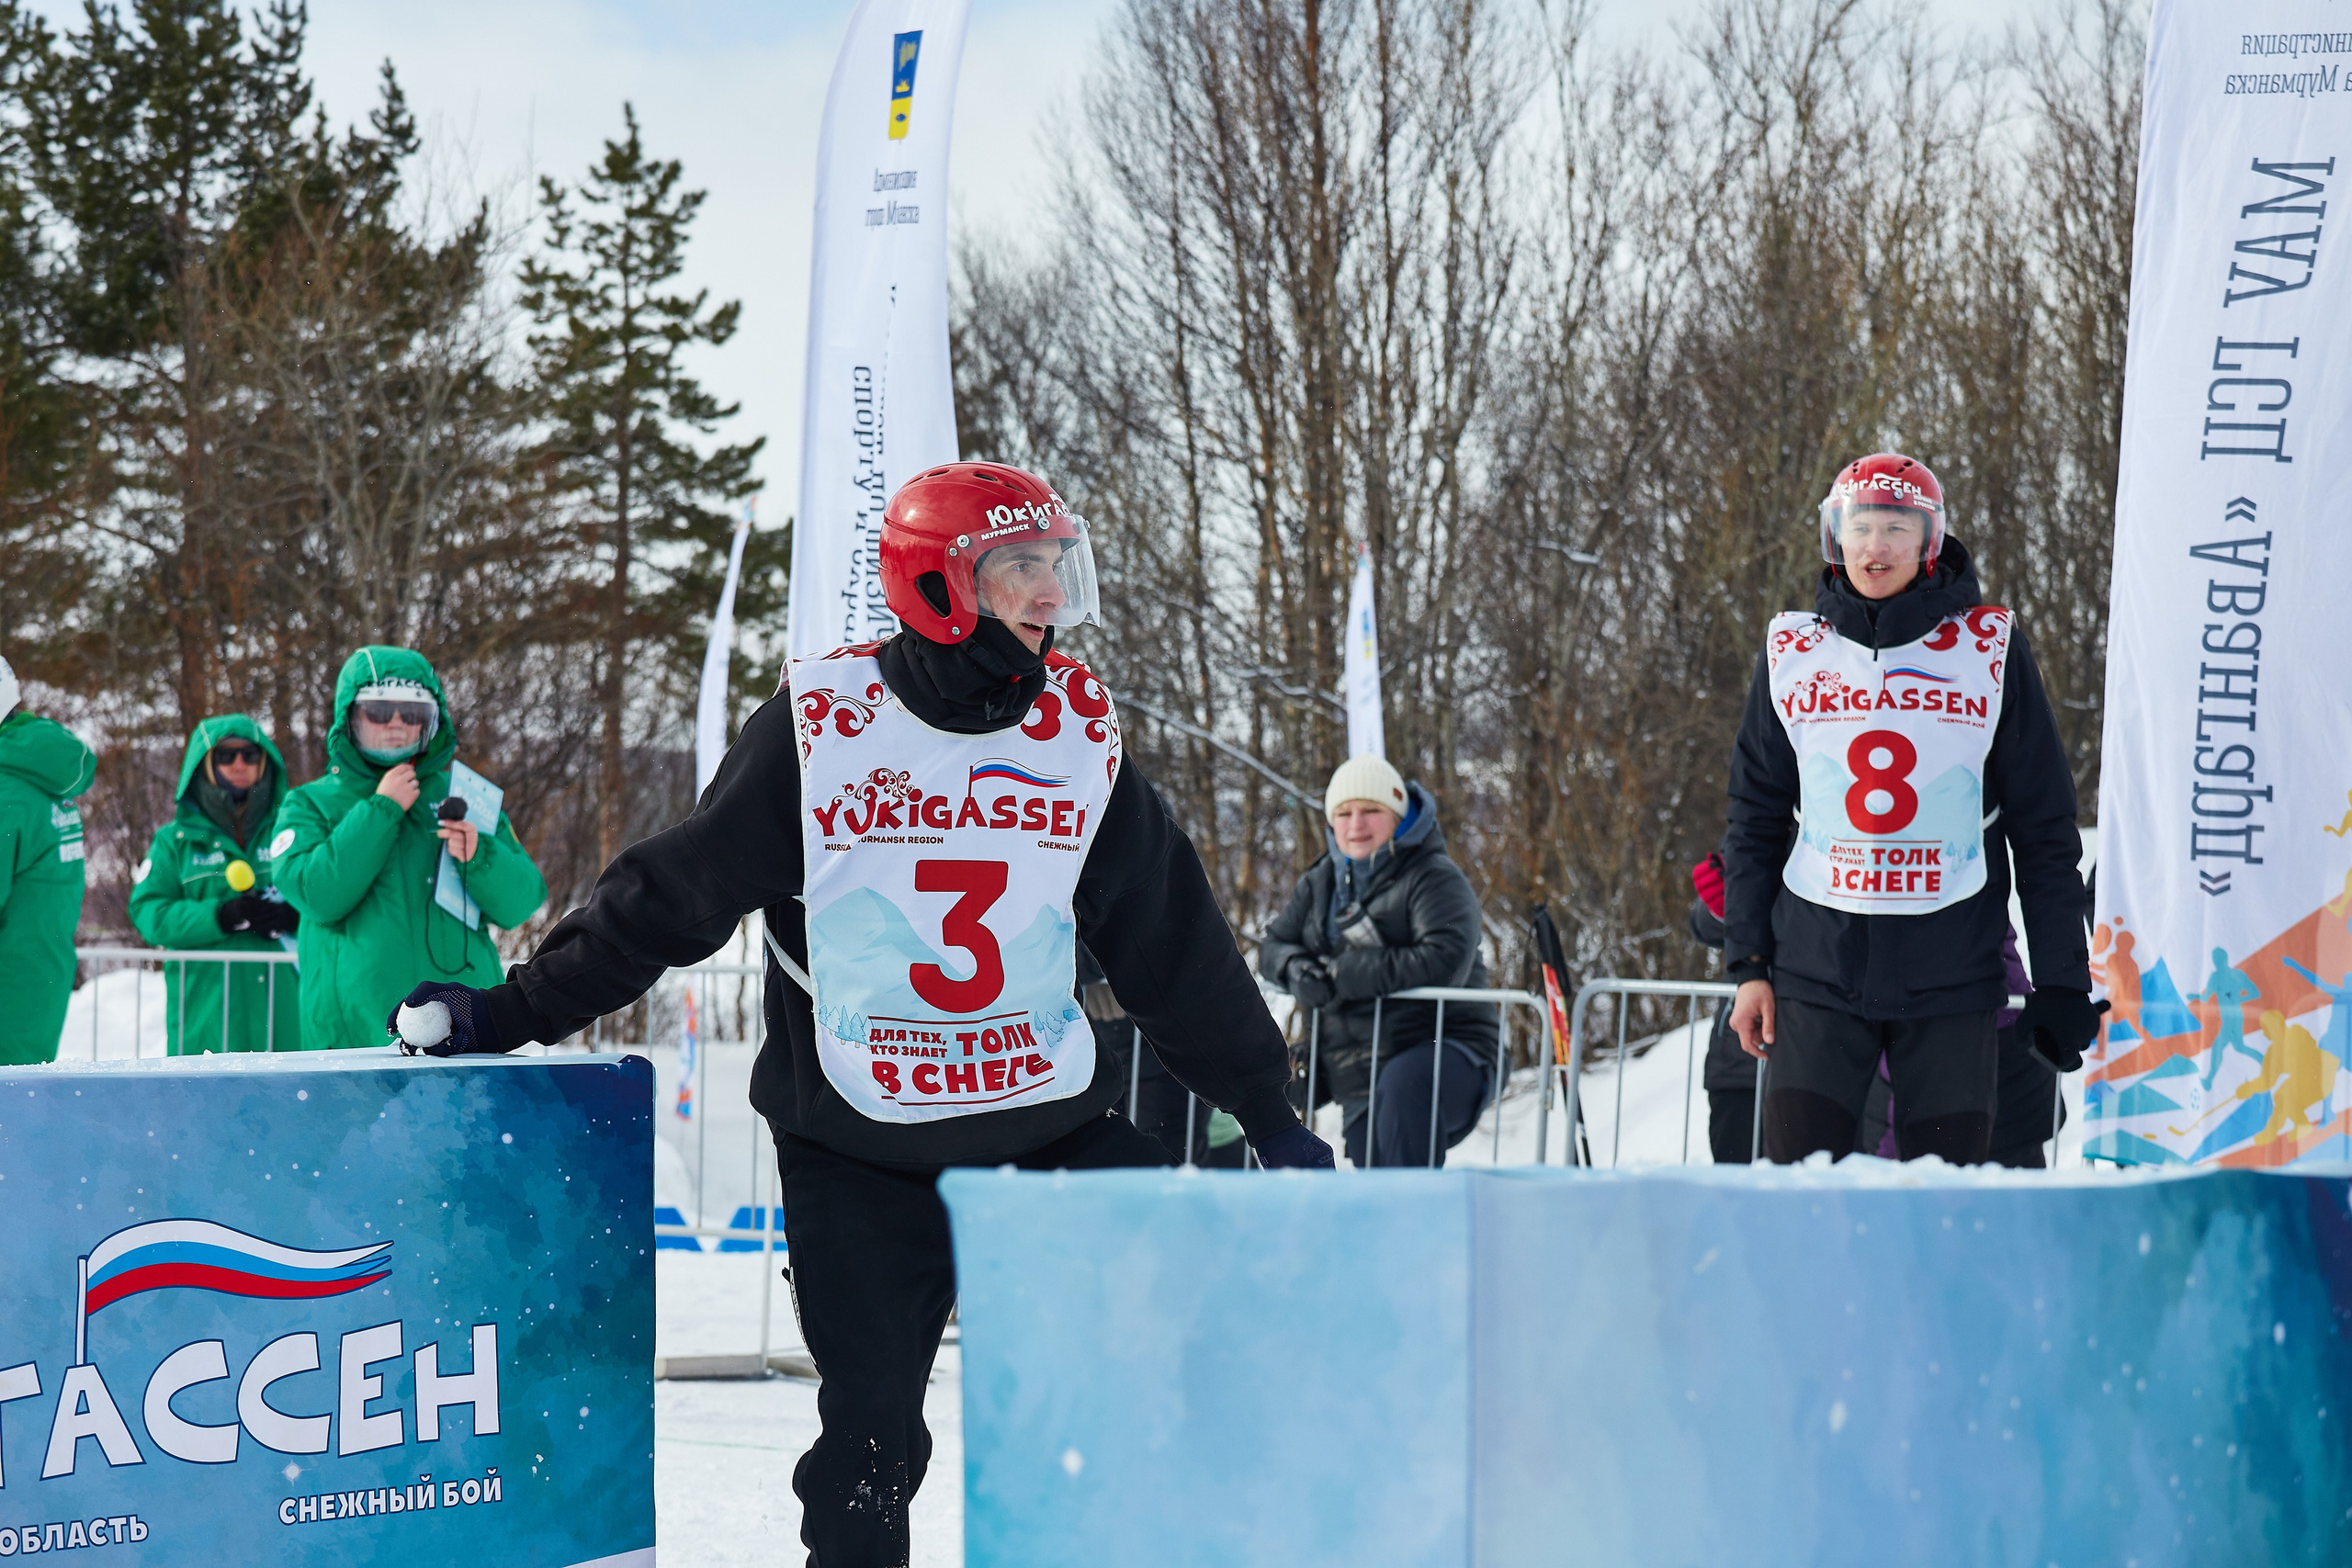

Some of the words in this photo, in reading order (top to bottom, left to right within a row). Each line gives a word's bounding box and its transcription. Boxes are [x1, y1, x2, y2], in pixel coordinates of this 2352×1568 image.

[853, 366, 876, 491] спорту
[980, 523, 1030, 540] МУРМАНСК
[1845, 729, 1918, 835] 8
[857, 835, 906, 844] URMANSK
[907, 836, 944, 844] REGION
[1037, 840, 1080, 852] СНЕЖНЫЙ
[1871, 848, 1941, 865] ТОЛК
[1832, 866, 1841, 888] В
[1845, 869, 1941, 892] СНЕГЕ
[910, 859, 1009, 1012] 3
[869, 1028, 907, 1043] ДЛЯ
[909, 1030, 947, 1046] ТЕХ,
[870, 1044, 899, 1055] КТО
[900, 1045, 948, 1058] ЗНАЕТ
[956, 1021, 1038, 1056] ТОЛК
[871, 1060, 902, 1095] В
[911, 1053, 1054, 1096] СНЕГЕ
[278, 1473, 436, 1526] СНЕЖНЫЙ
[442, 1467, 503, 1509] БОЙ
[0, 1514, 149, 1558] ОБЛАСТЬ
